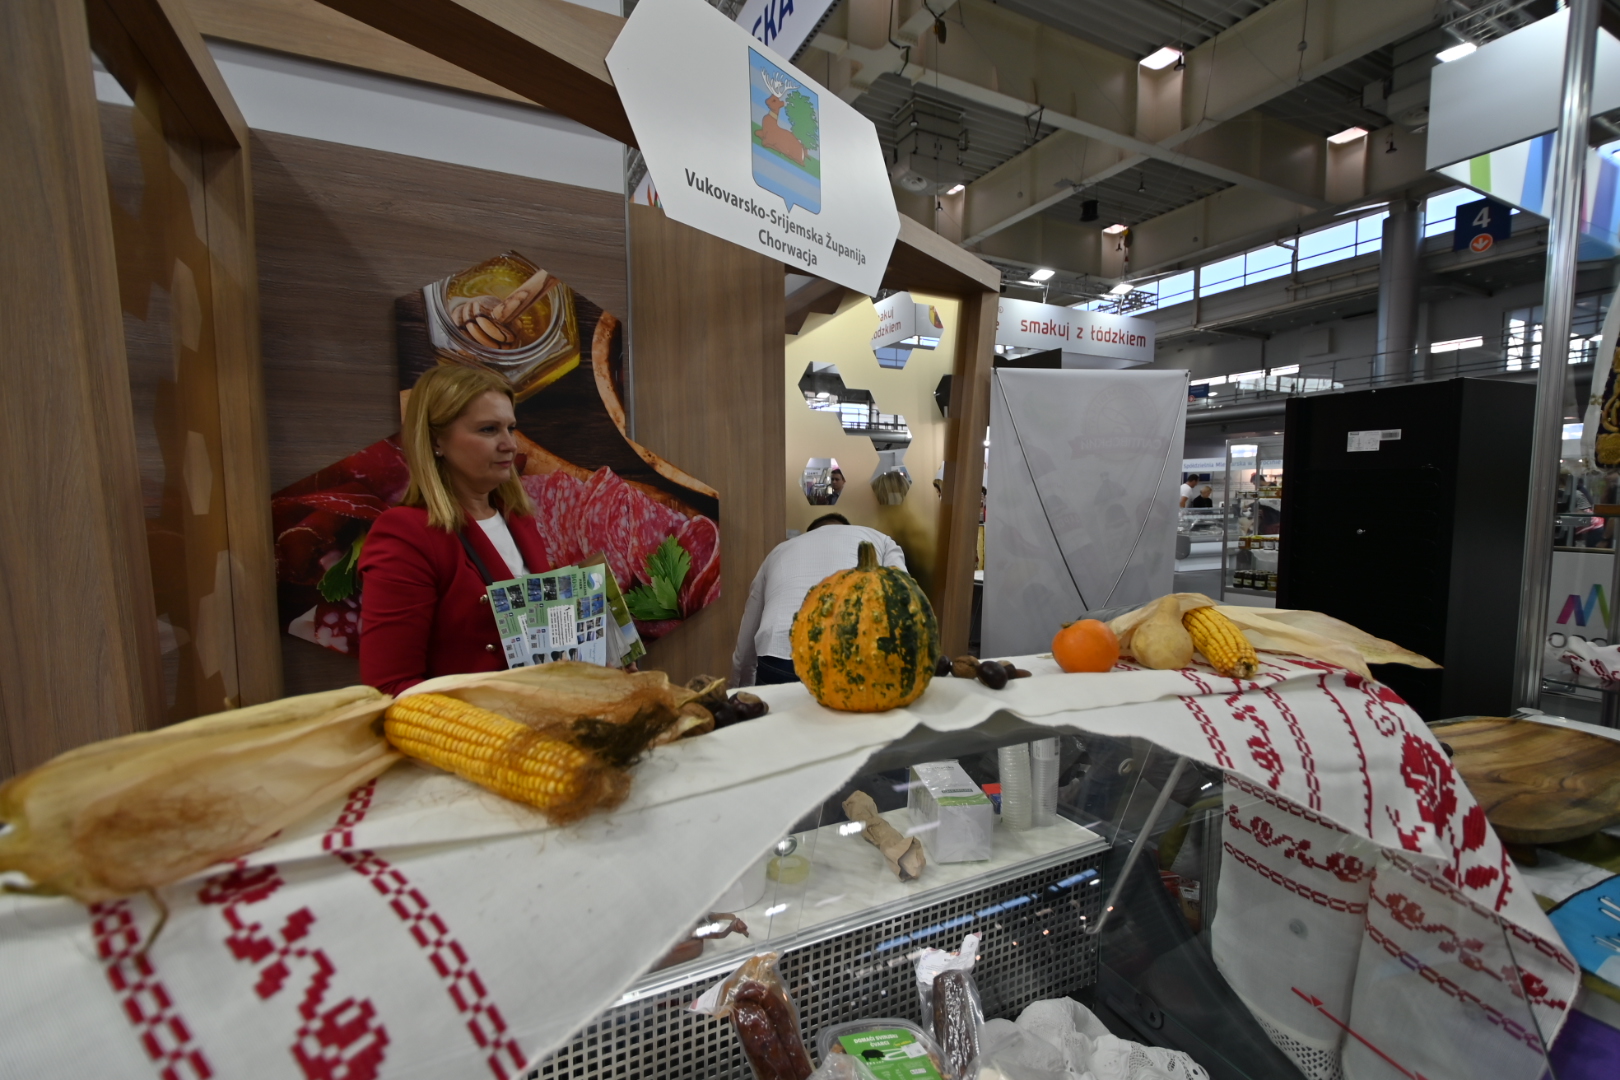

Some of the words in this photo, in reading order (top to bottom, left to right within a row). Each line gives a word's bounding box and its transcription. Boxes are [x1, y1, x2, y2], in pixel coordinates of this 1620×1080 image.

[684, 167, 823, 245] Vukovarsko-Srijemska
[825, 231, 866, 265] Županija
[1472, 206, 1491, 228] 4
[758, 228, 818, 267] Chorwacja
[878, 306, 894, 322] akuj
[1020, 318, 1070, 341] smakuj
[1077, 327, 1083, 339] z
[1091, 324, 1147, 348] łódzkiem
